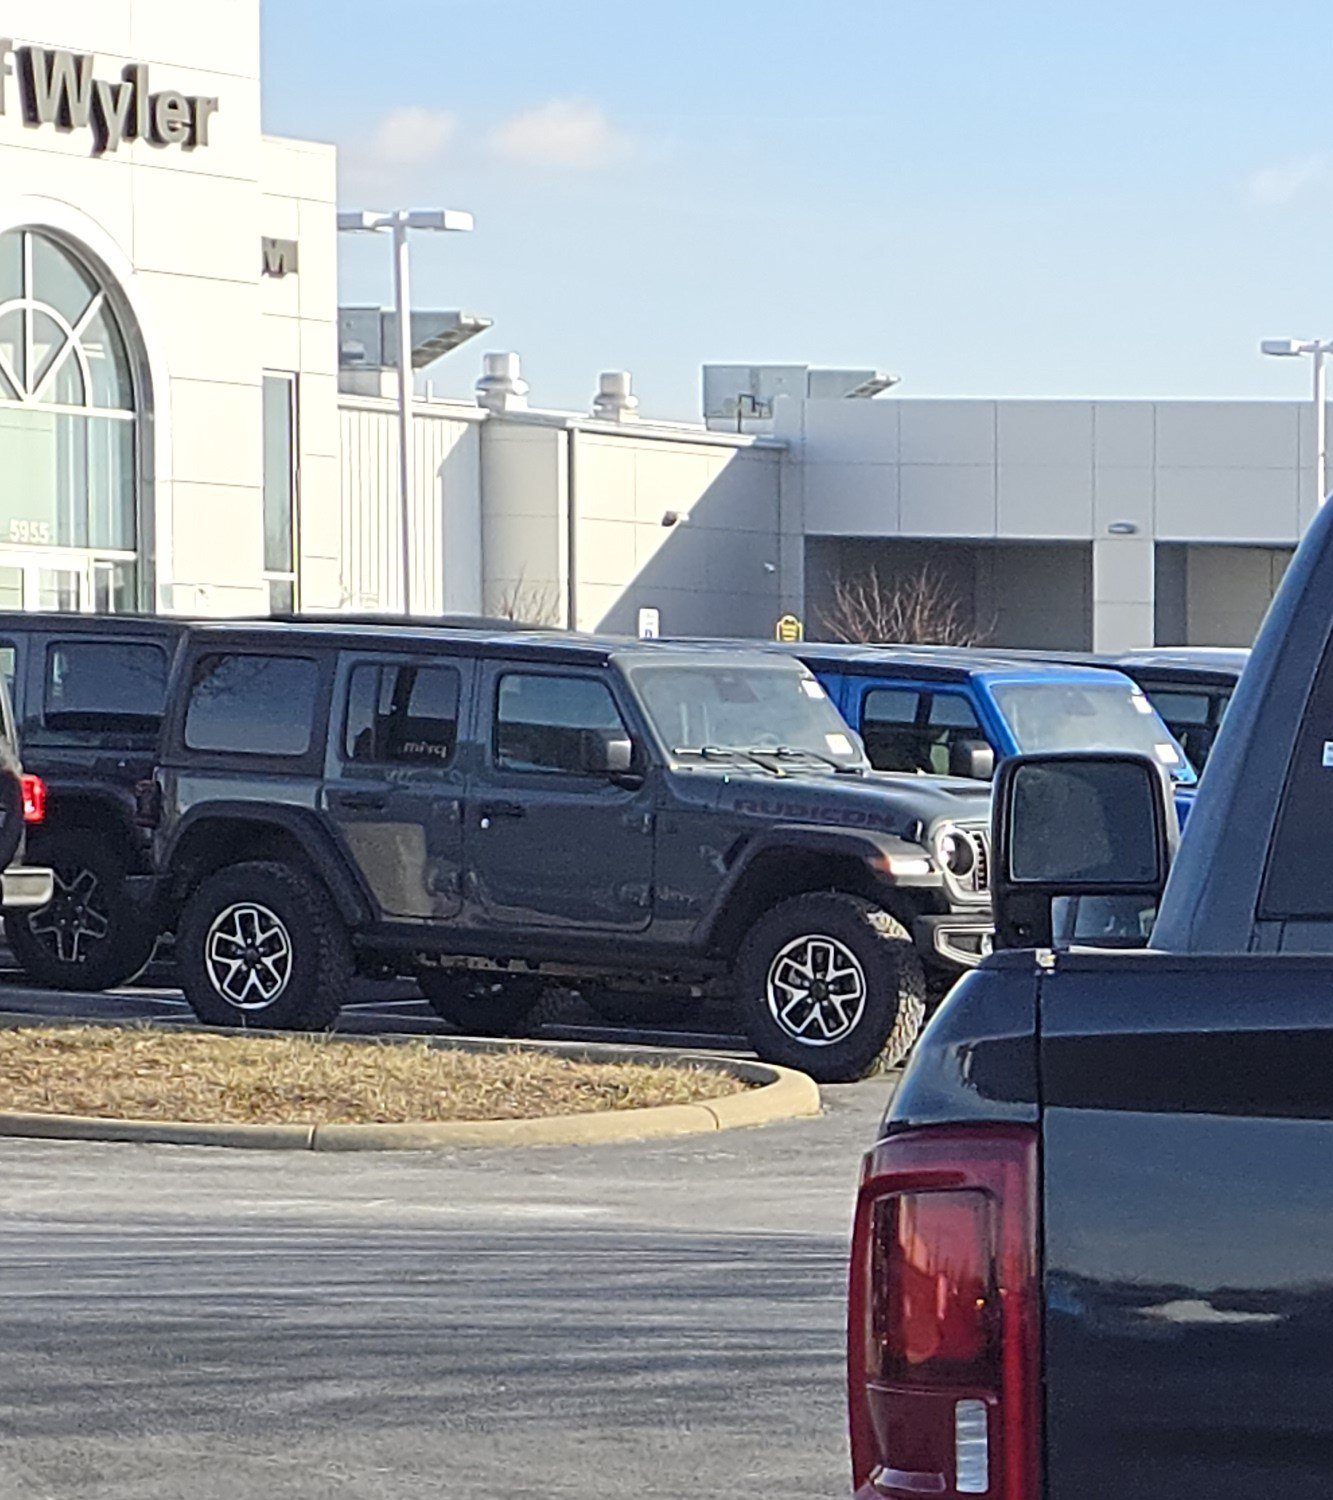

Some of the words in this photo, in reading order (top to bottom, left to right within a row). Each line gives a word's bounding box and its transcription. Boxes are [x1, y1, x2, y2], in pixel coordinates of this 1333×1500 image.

[15, 46, 219, 157] Wyler
[10, 519, 49, 543] 5955
[734, 799, 896, 828] RUBICON
